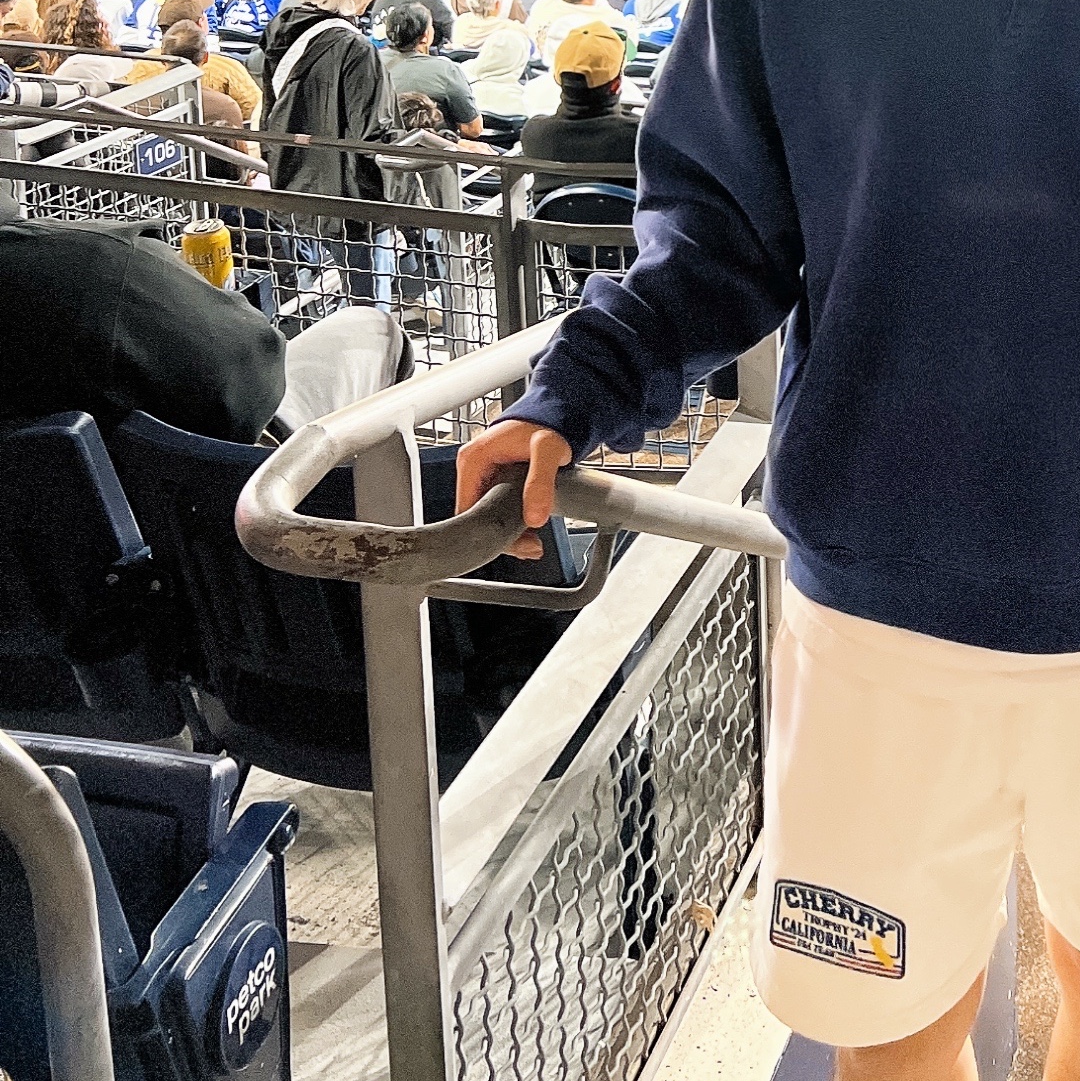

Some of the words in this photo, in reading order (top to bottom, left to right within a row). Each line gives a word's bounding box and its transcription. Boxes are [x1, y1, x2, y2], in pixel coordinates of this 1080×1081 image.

[144, 138, 176, 167] 106
[783, 886, 896, 938] CHERRY
[802, 910, 849, 936] TROPHY
[781, 916, 857, 955] CALIFORNIA
[226, 946, 276, 1035] petco
[238, 967, 277, 1046] park
